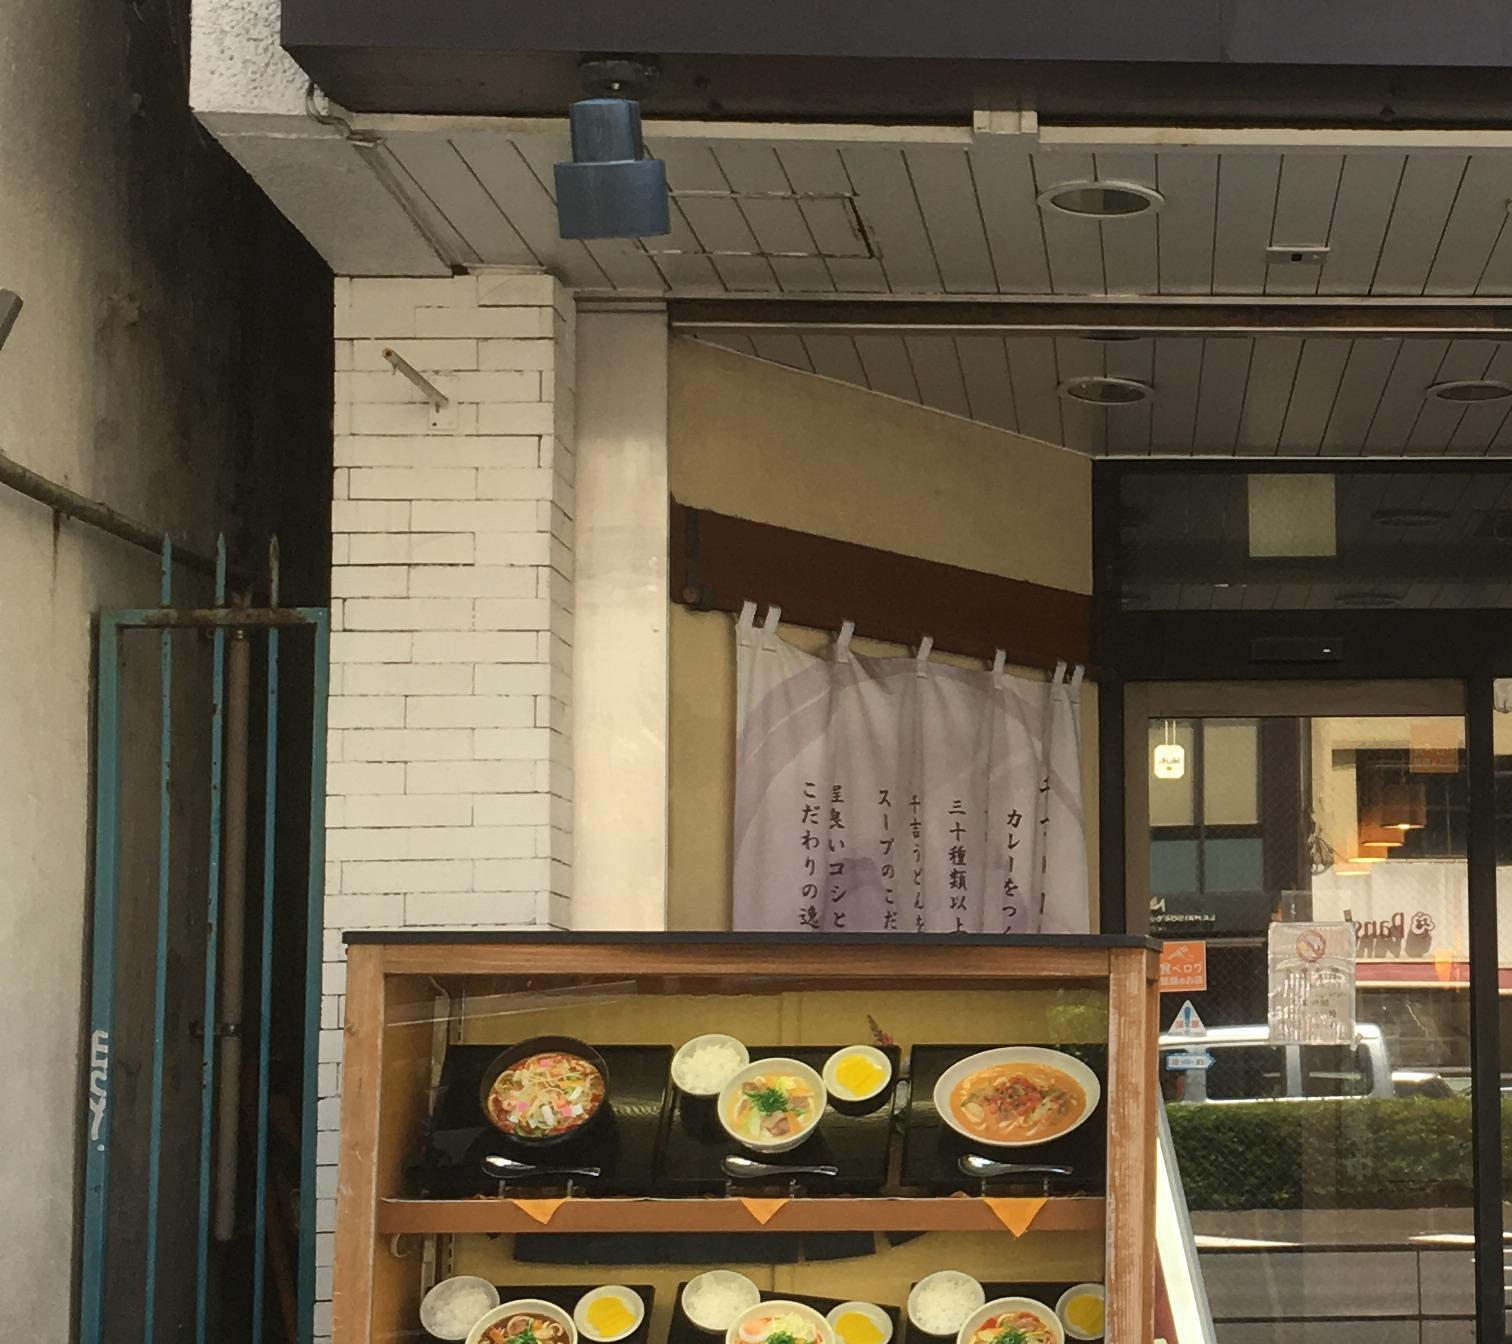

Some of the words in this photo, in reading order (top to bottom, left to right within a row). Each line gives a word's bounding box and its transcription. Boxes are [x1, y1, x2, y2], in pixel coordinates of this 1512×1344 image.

[878, 789, 897, 930] スープのこだ
